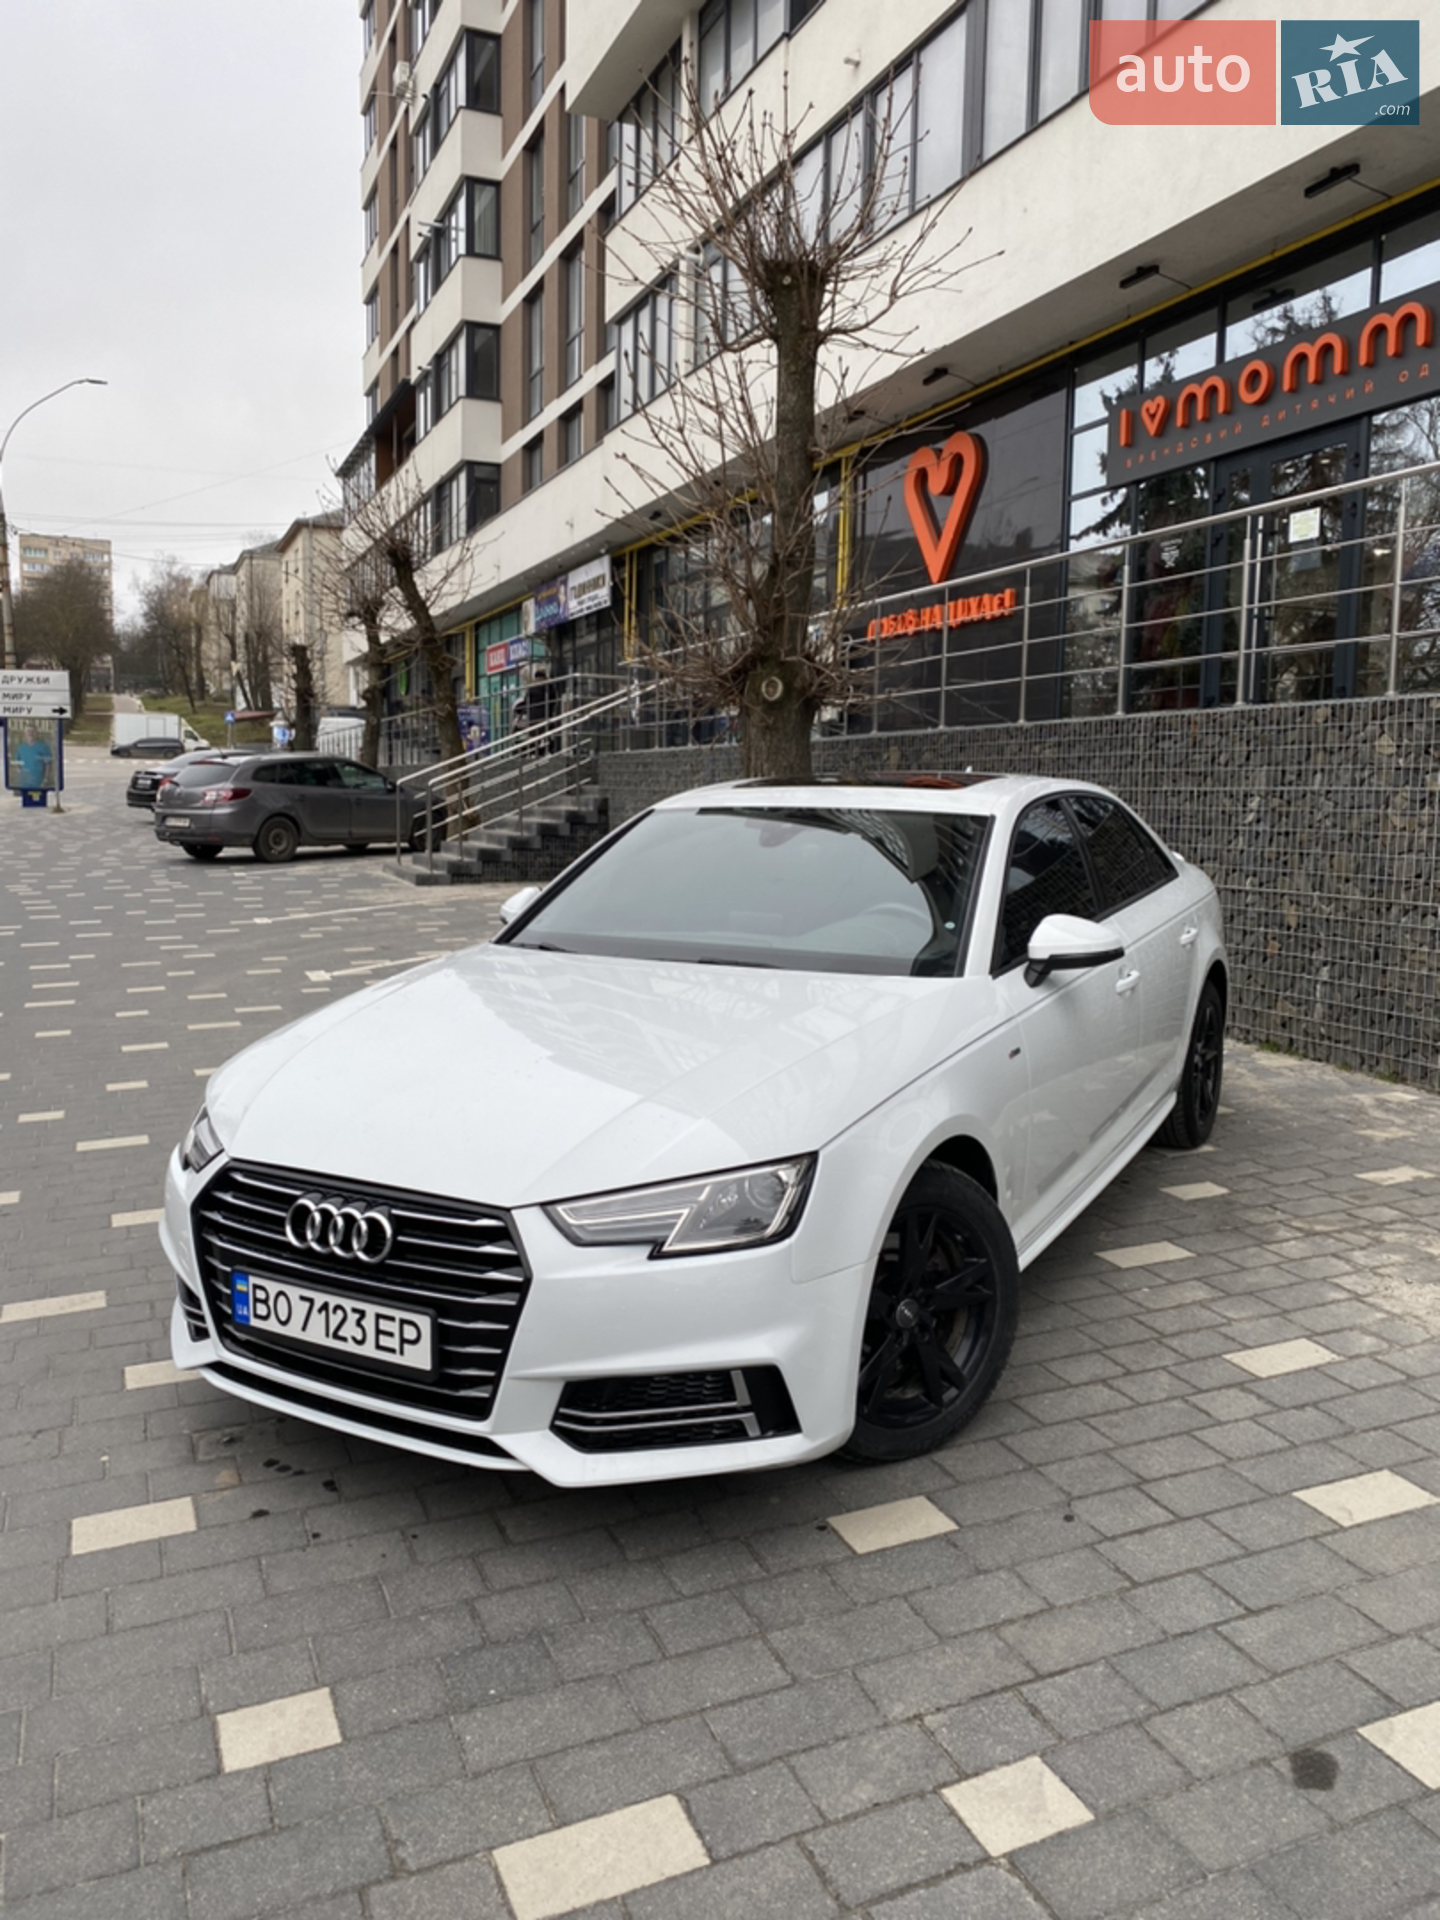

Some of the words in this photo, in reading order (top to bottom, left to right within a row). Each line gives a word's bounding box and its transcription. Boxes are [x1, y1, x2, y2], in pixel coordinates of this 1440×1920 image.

[1261, 379, 1374, 428] ДИТЯЧИЙ
[1, 675, 51, 685] ДРУЖБИ
[2, 692, 33, 701] МИРУ
[2, 706, 33, 715] МИРУ
[299, 1294, 367, 1346] 7123
